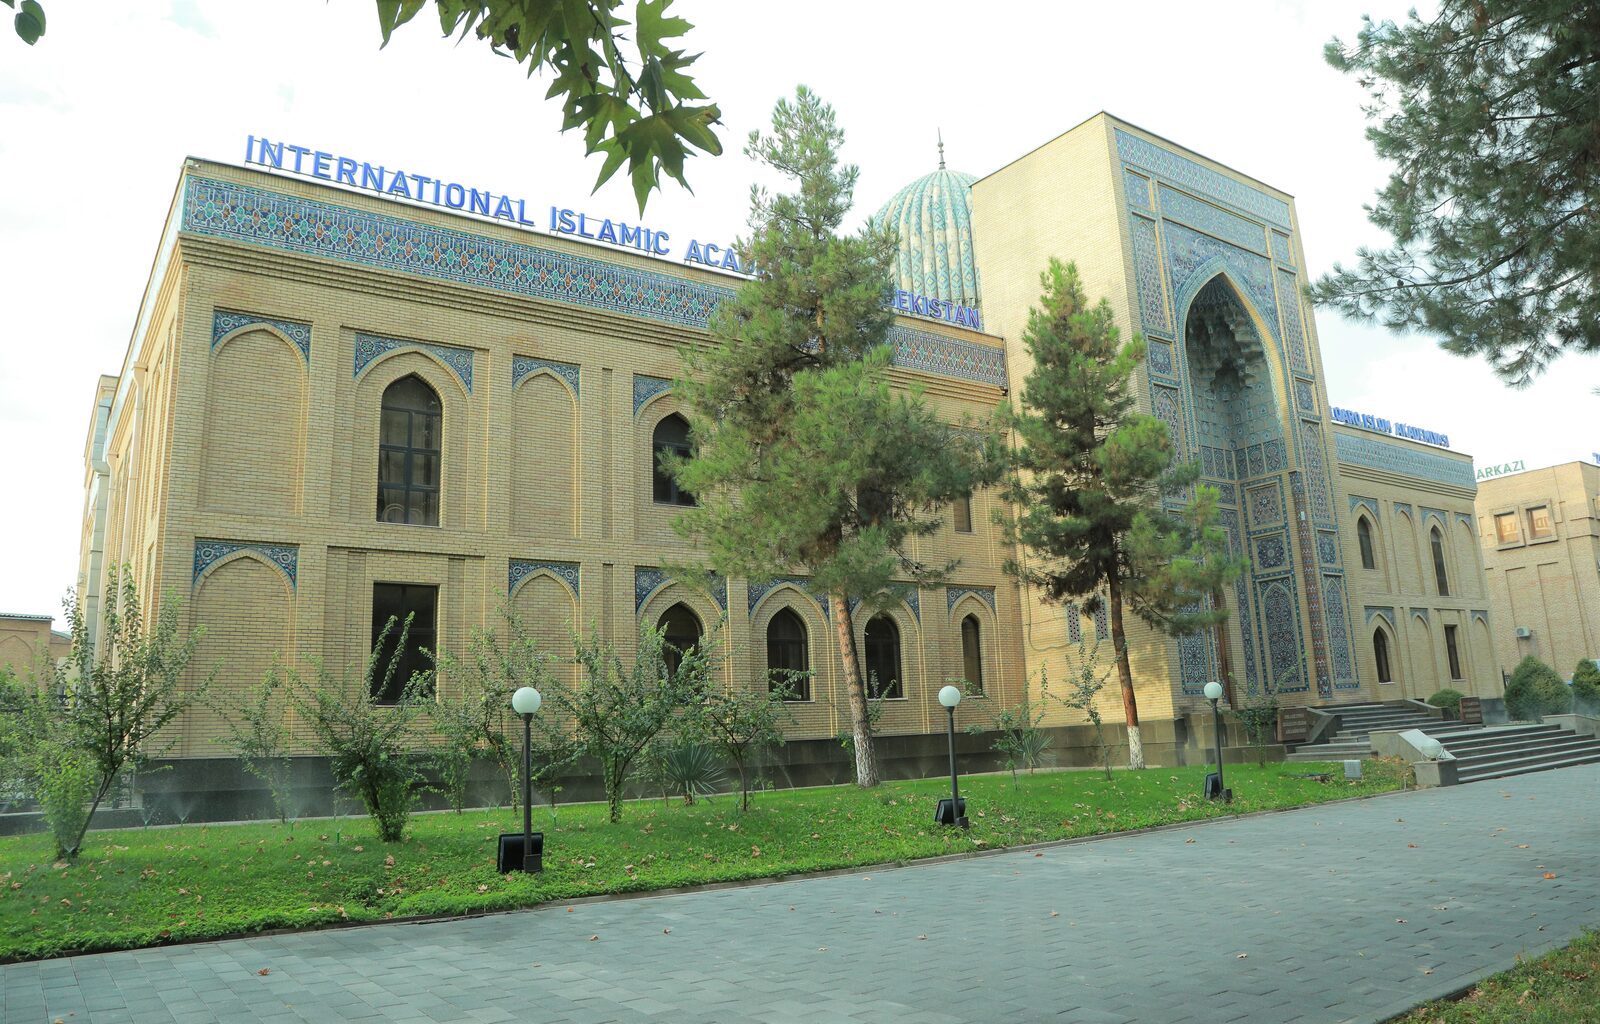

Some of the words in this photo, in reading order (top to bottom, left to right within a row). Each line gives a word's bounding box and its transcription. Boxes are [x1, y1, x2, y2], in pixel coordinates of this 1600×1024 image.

[245, 134, 535, 226] INTERNATIONAL
[550, 206, 670, 255] ISLAMIC
[1476, 459, 1526, 480] ARKAZI
